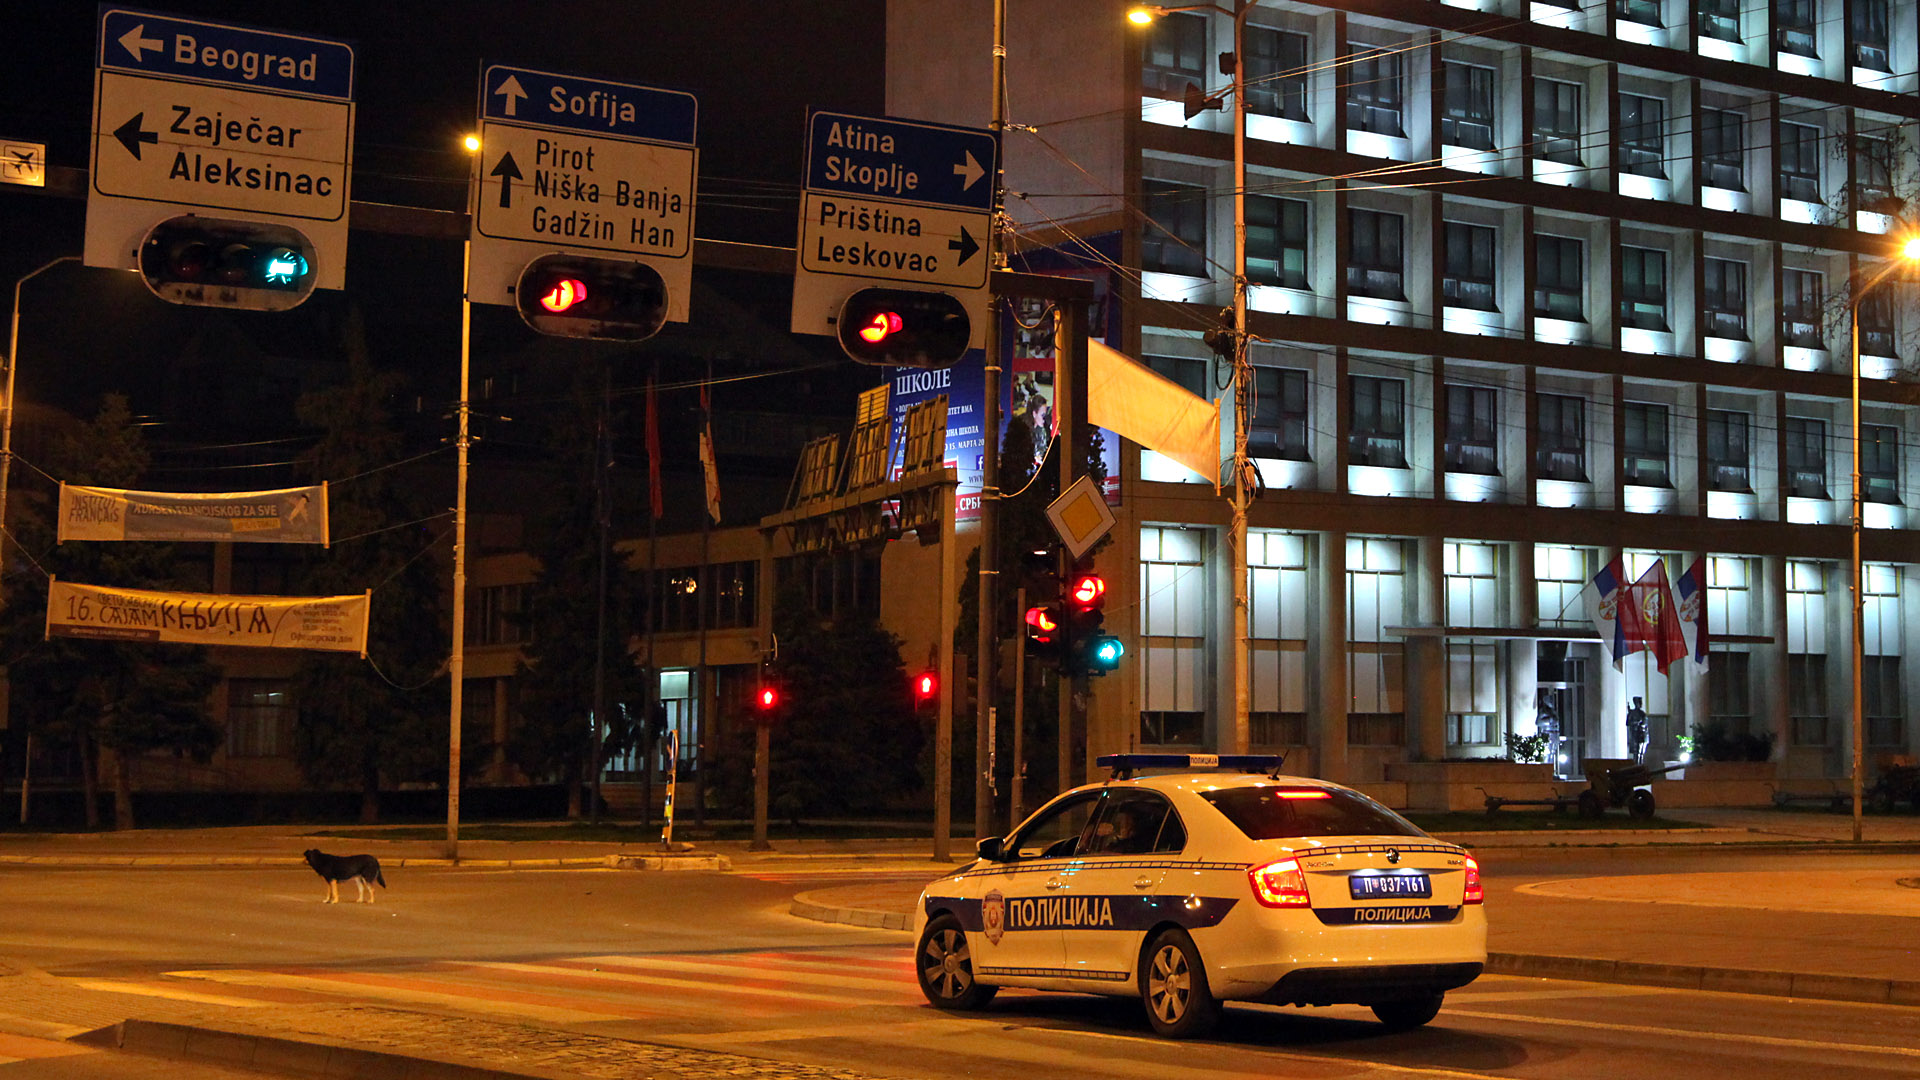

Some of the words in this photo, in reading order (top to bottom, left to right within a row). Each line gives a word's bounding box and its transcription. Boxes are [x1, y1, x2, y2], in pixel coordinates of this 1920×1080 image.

[175, 33, 317, 81] Beograd
[549, 86, 636, 127] Sofija
[170, 105, 302, 149] Zaječar
[826, 121, 895, 154] Atina
[536, 138, 595, 172] Pirot
[169, 151, 333, 197] Aleksinac
[825, 155, 919, 194] Skoplje
[534, 169, 600, 204] Niška
[616, 180, 682, 218] Banja
[532, 205, 614, 241] Gadžin
[630, 218, 674, 248] Han
[820, 201, 921, 237] Priština
[817, 236, 938, 273] Leskovac
[896, 367, 951, 395] ШКОЛЕ
[958, 439, 977, 449] МАРТА
[959, 425, 979, 436] ШКОЛА
[69, 507, 120, 524] FRANÇAIS
[243, 505, 256, 517] ZA
[258, 505, 278, 516] SVE
[66, 595, 94, 621] 16.
[161, 600, 272, 633] КЊИГА
[1010, 897, 1114, 927] ПОЛИЦИЈА
[1354, 907, 1431, 922] ПОЛИЦИЈА
